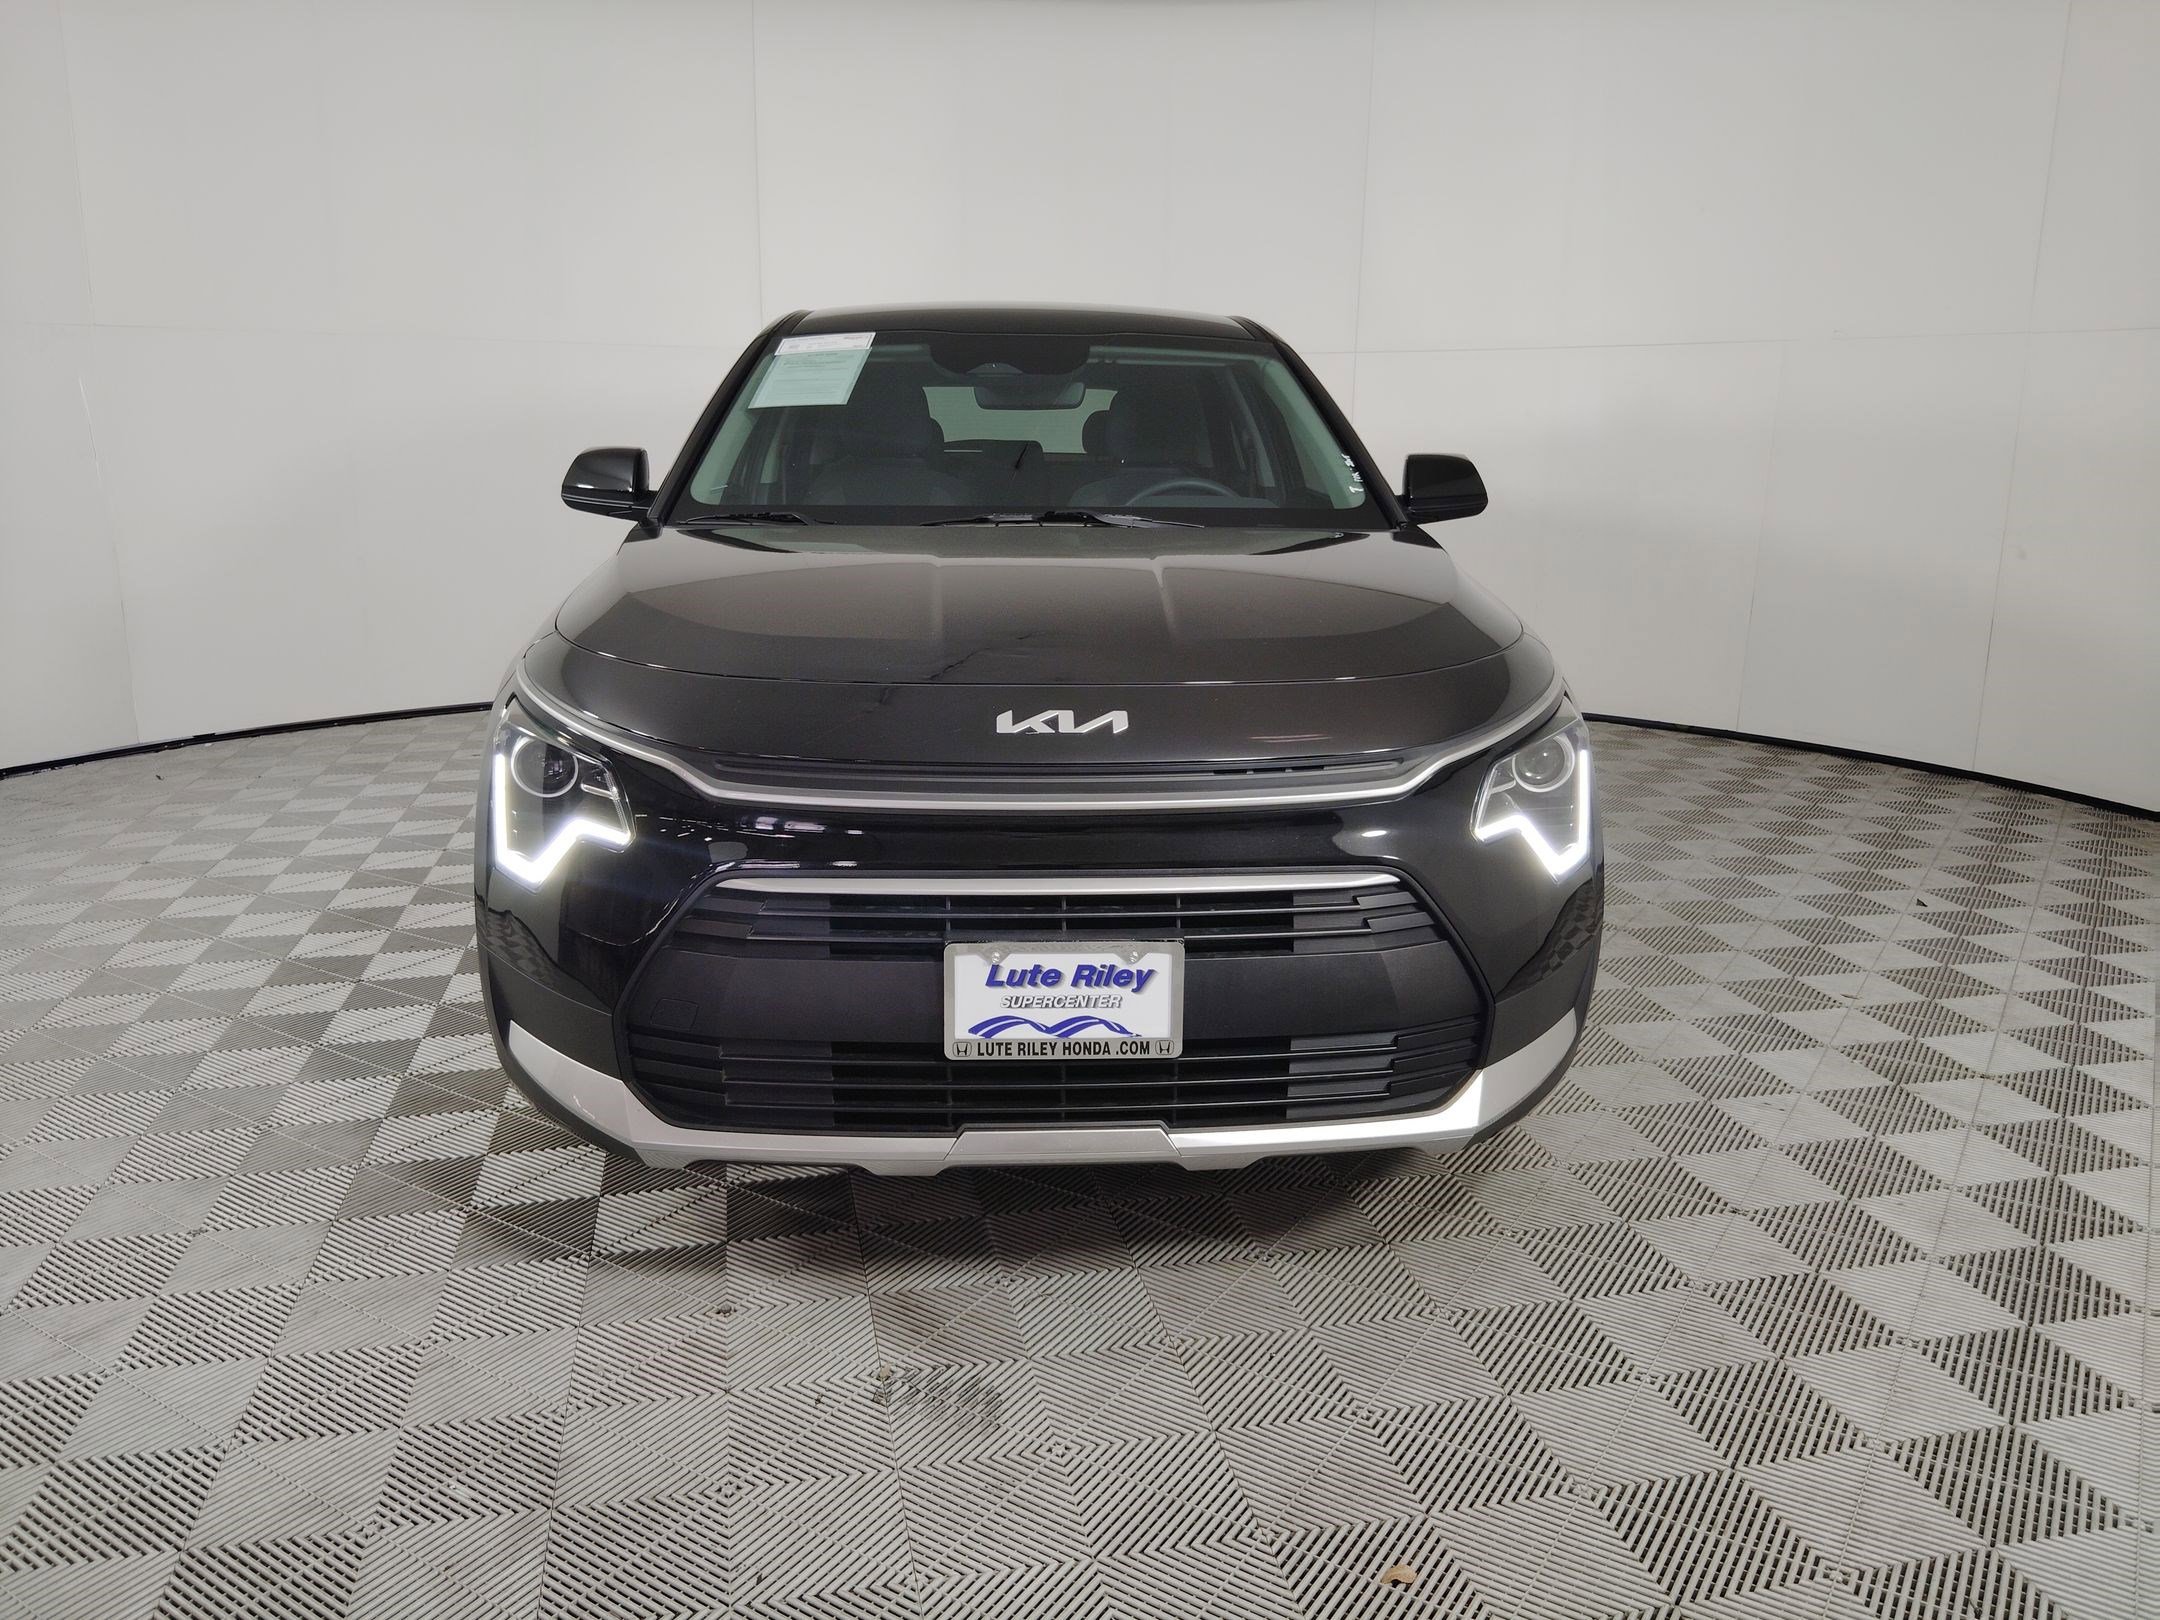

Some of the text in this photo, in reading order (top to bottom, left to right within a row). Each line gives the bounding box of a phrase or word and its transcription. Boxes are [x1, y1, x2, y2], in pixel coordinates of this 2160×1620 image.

[996, 709, 1129, 734] KIA
[985, 964, 1156, 992] Lute Riley
[1000, 994, 1123, 1009] SUPERCENTER
[977, 1041, 1150, 1057] LUTE RILEY HONDA .COM
